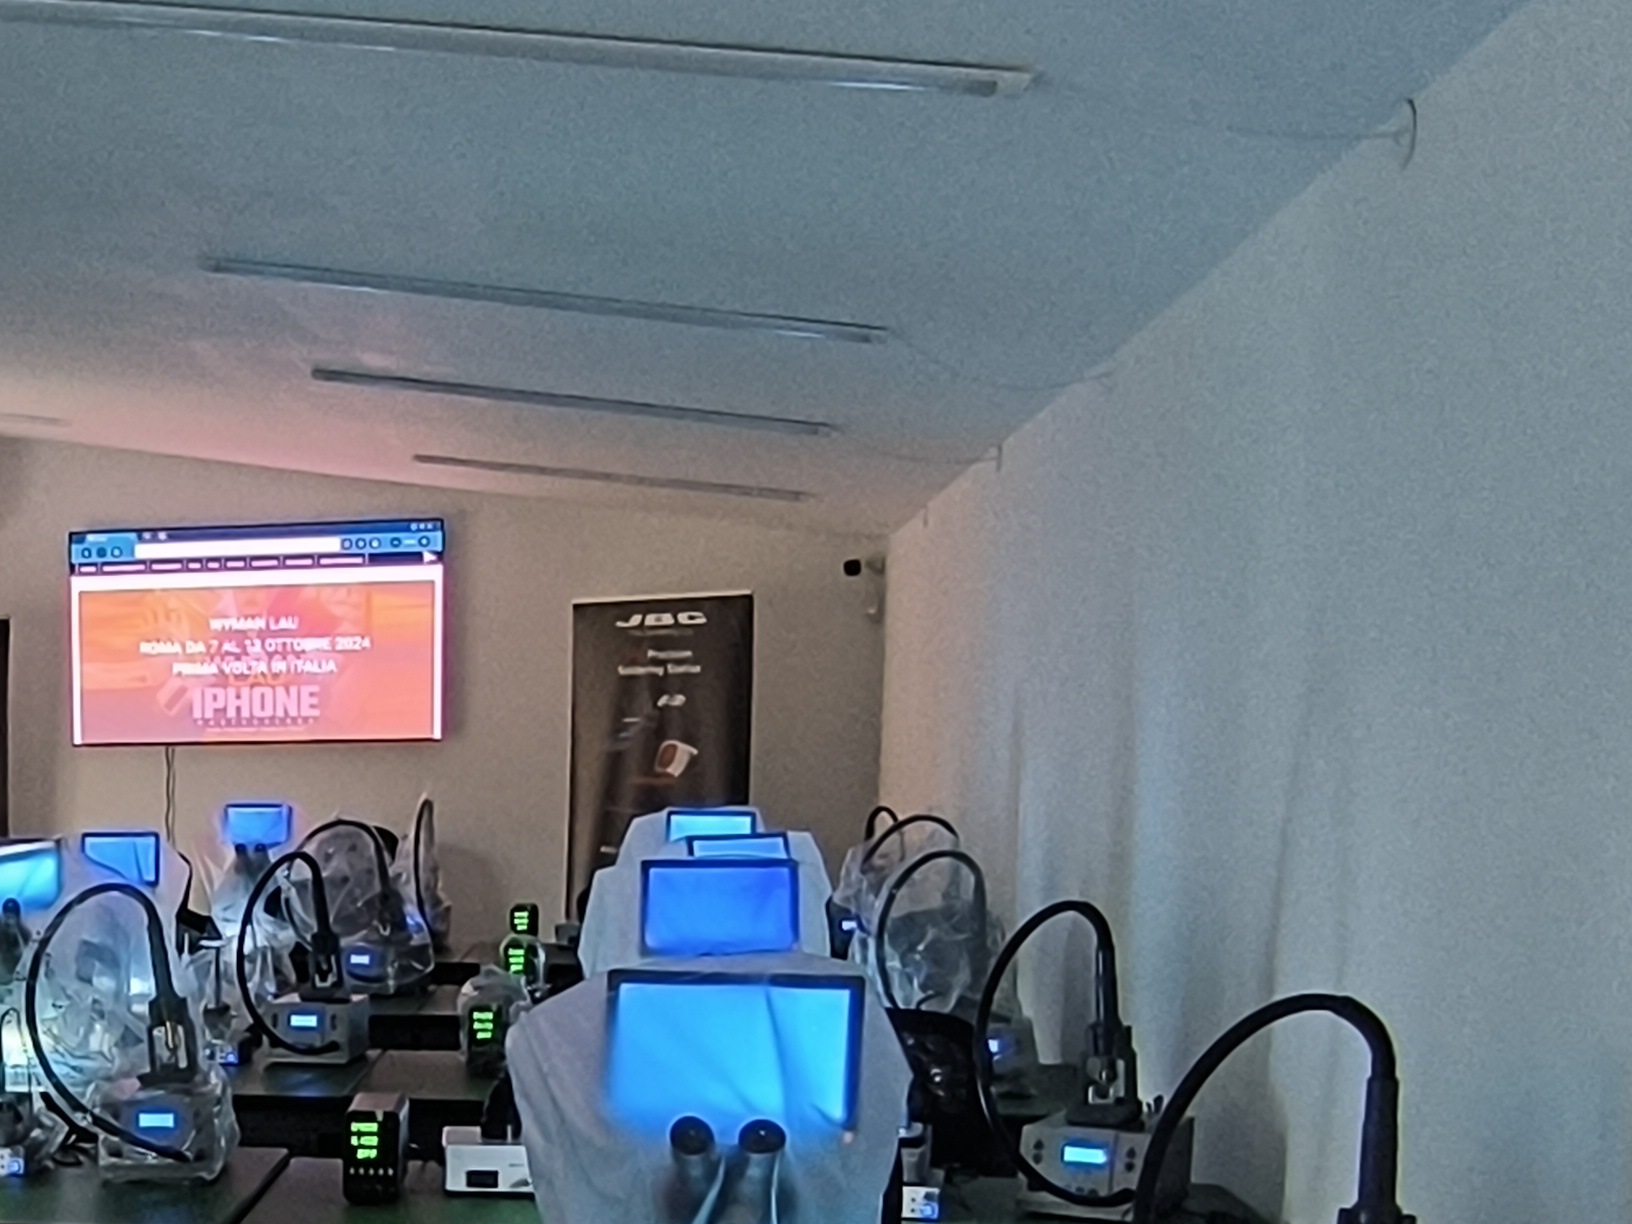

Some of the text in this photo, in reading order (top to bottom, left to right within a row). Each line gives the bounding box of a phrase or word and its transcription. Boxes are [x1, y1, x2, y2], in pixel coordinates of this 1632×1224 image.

[269, 615, 299, 630] LAU
[186, 640, 206, 654] DA
[208, 639, 219, 654] 7
[221, 639, 241, 654] AL
[334, 635, 370, 651] 2024
[221, 660, 268, 676] VOLTA
[290, 658, 337, 674] ITALIA
[192, 684, 320, 719] IPHONE
